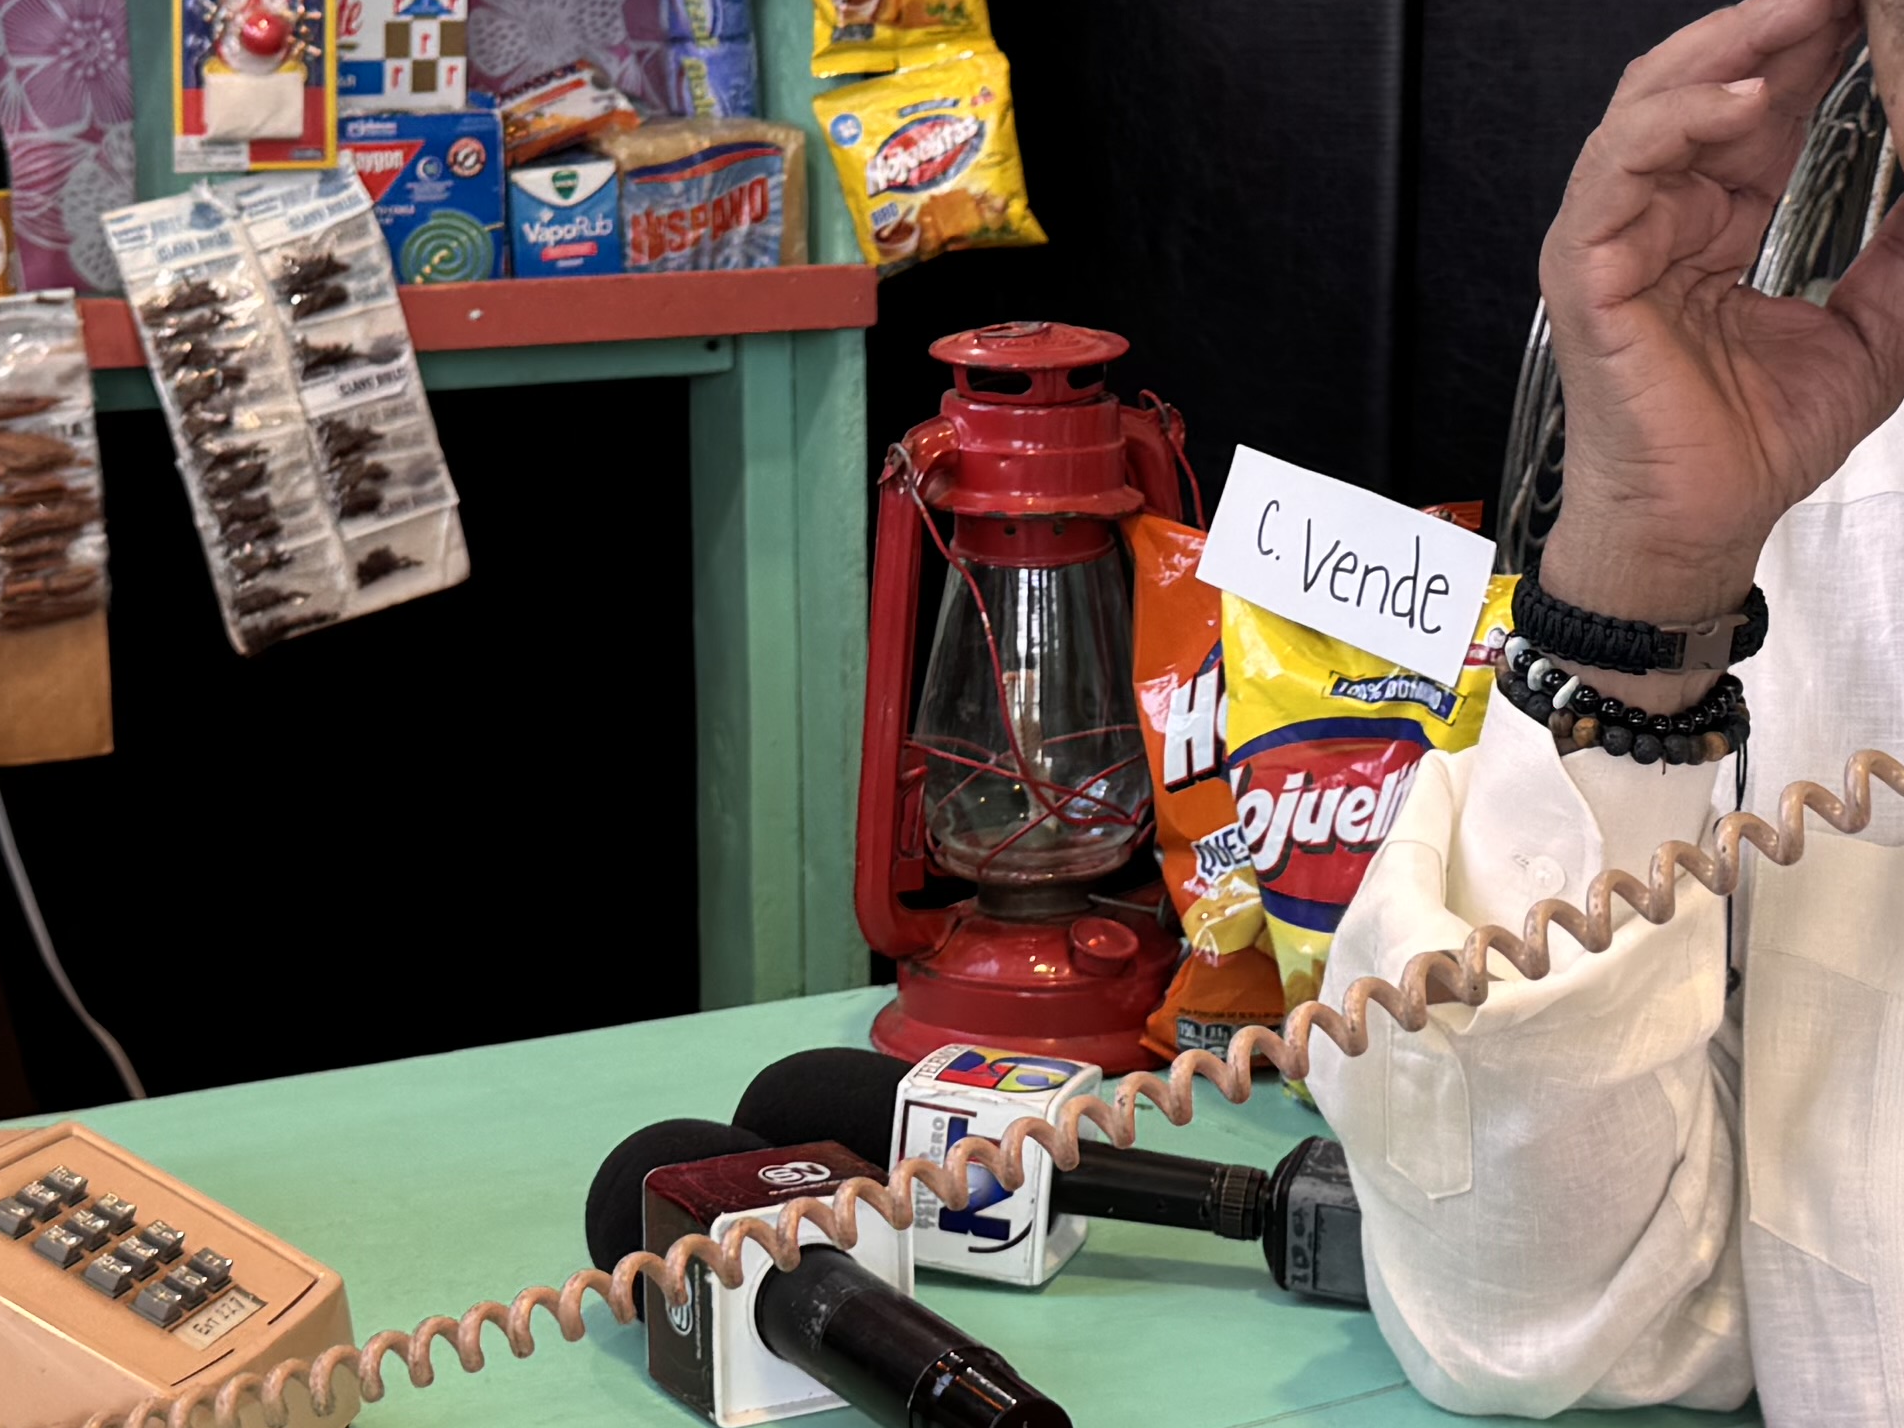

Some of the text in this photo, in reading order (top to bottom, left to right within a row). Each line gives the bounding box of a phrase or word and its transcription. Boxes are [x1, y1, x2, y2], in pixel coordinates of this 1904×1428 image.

[353, 148, 405, 173] aygon
[522, 209, 613, 243] VapoRub
[1303, 518, 1450, 635] Vende
